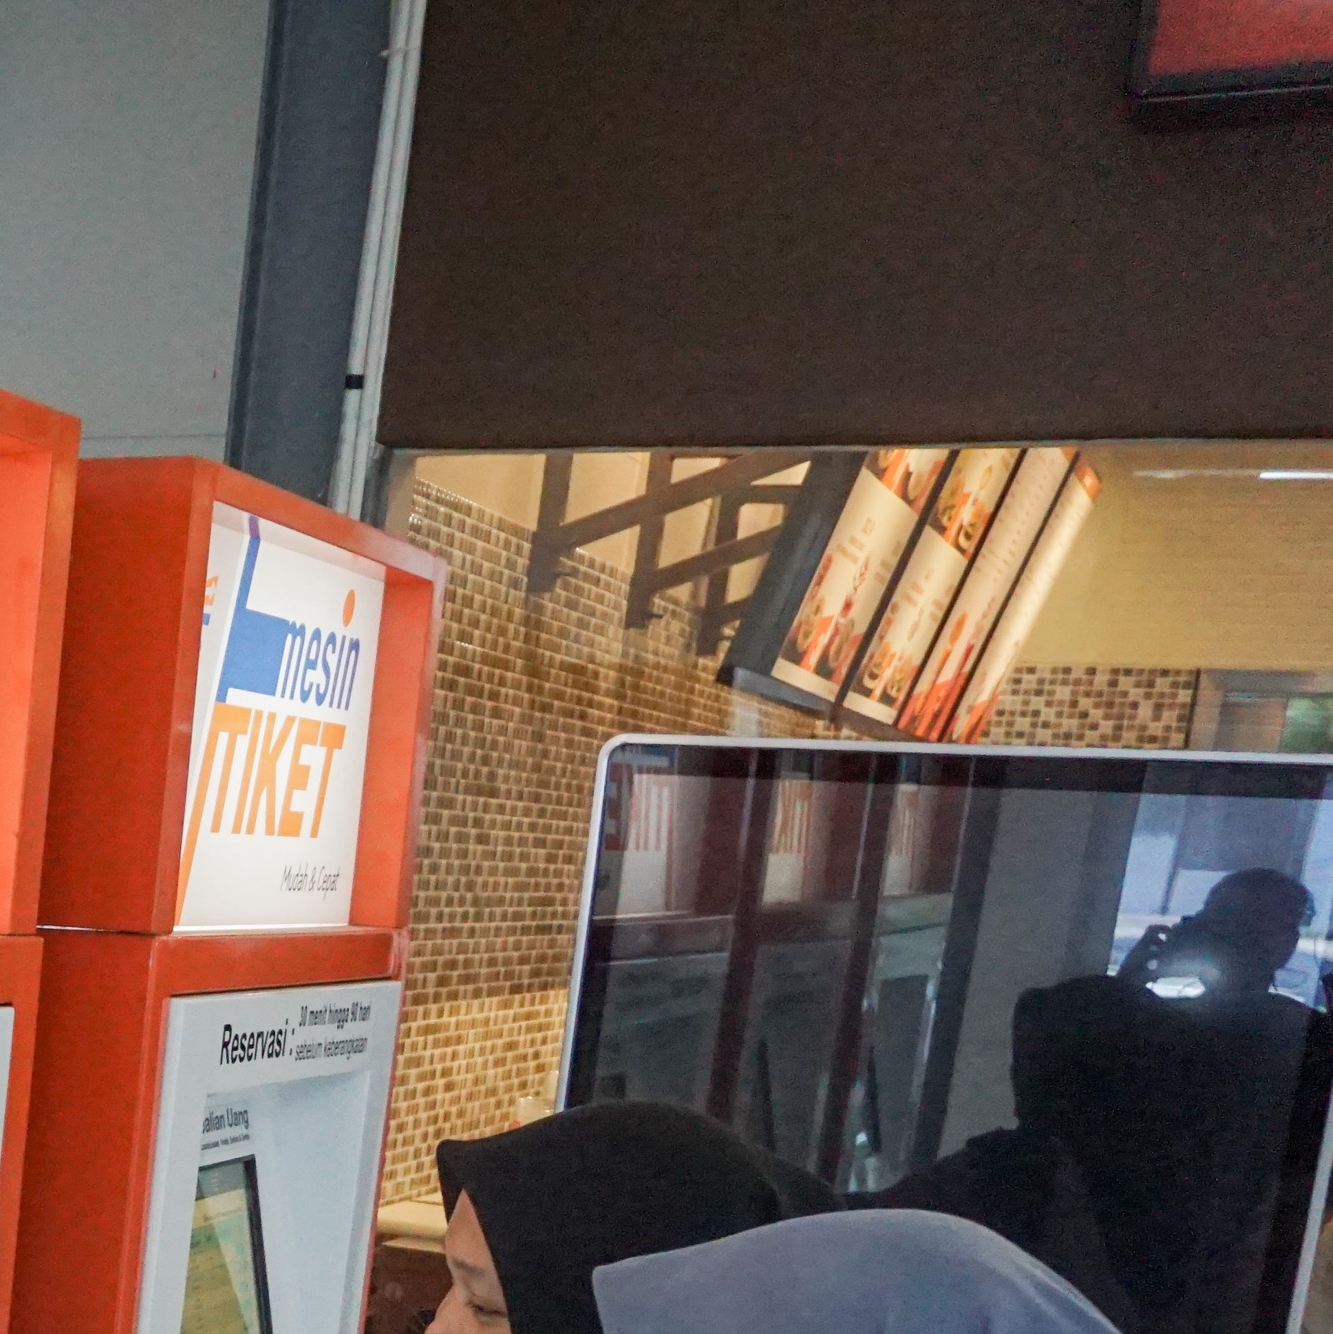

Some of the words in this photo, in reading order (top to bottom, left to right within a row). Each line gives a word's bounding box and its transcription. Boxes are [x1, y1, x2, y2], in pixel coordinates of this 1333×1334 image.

[273, 589, 361, 711] mesin
[209, 701, 347, 839] TIKET
[280, 862, 308, 892] Mudah
[308, 868, 317, 892] &
[317, 865, 340, 901] Cepat
[220, 1018, 289, 1065] Reservasi
